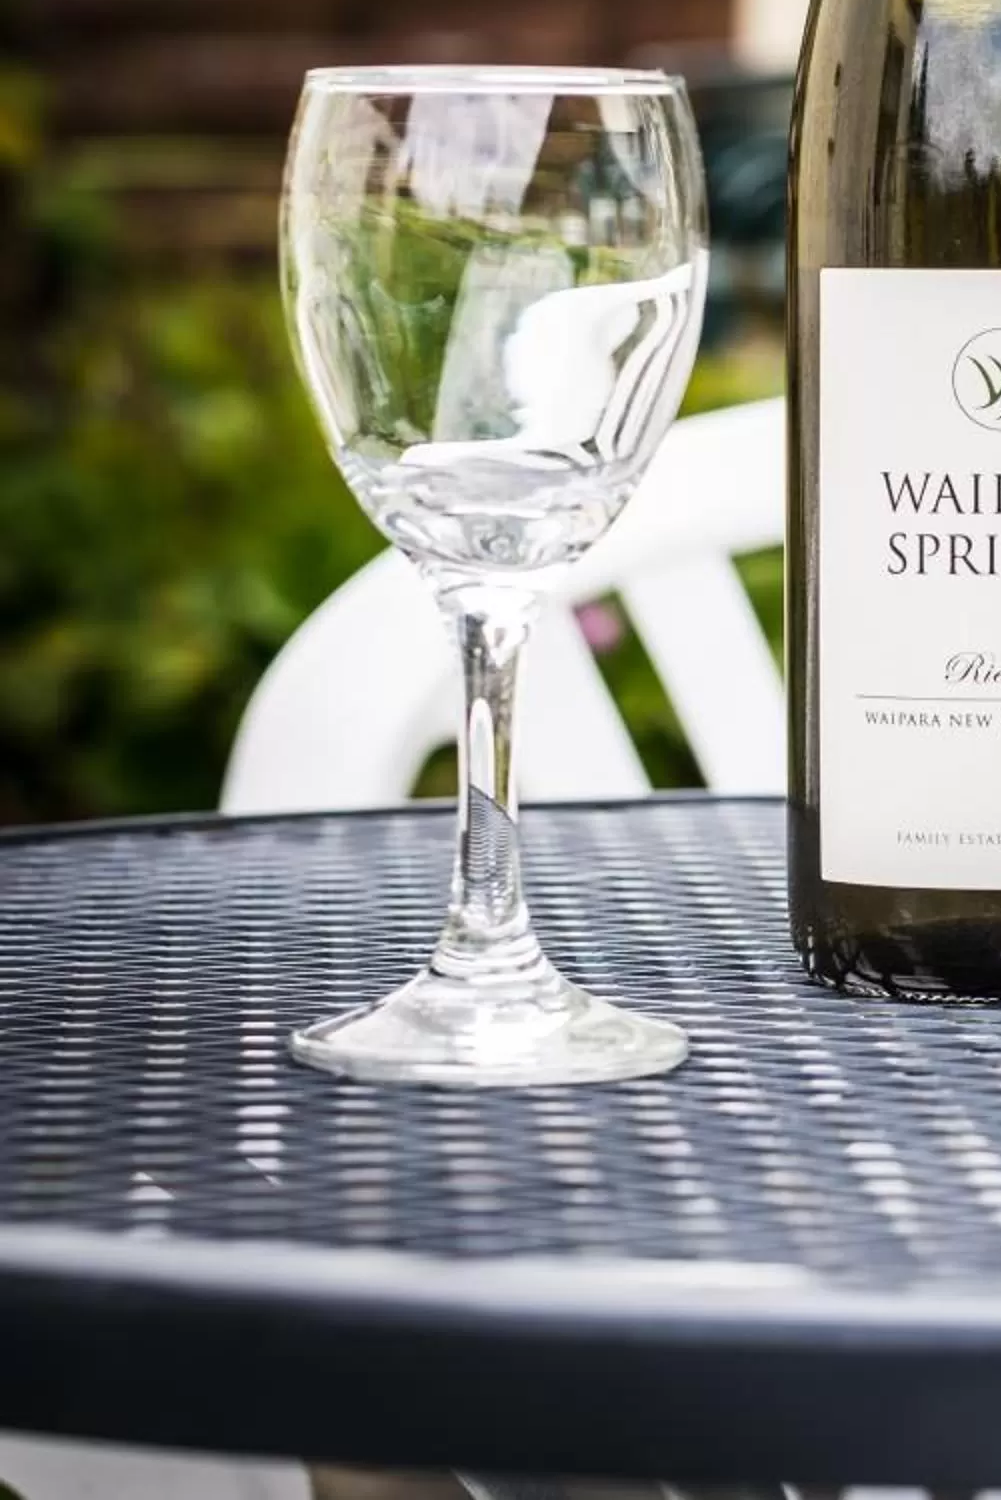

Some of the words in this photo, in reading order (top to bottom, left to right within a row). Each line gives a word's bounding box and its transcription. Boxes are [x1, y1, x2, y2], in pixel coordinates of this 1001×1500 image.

[864, 710, 942, 728] WAIPARA
[949, 712, 993, 729] NEW
[896, 830, 950, 846] FAMILY
